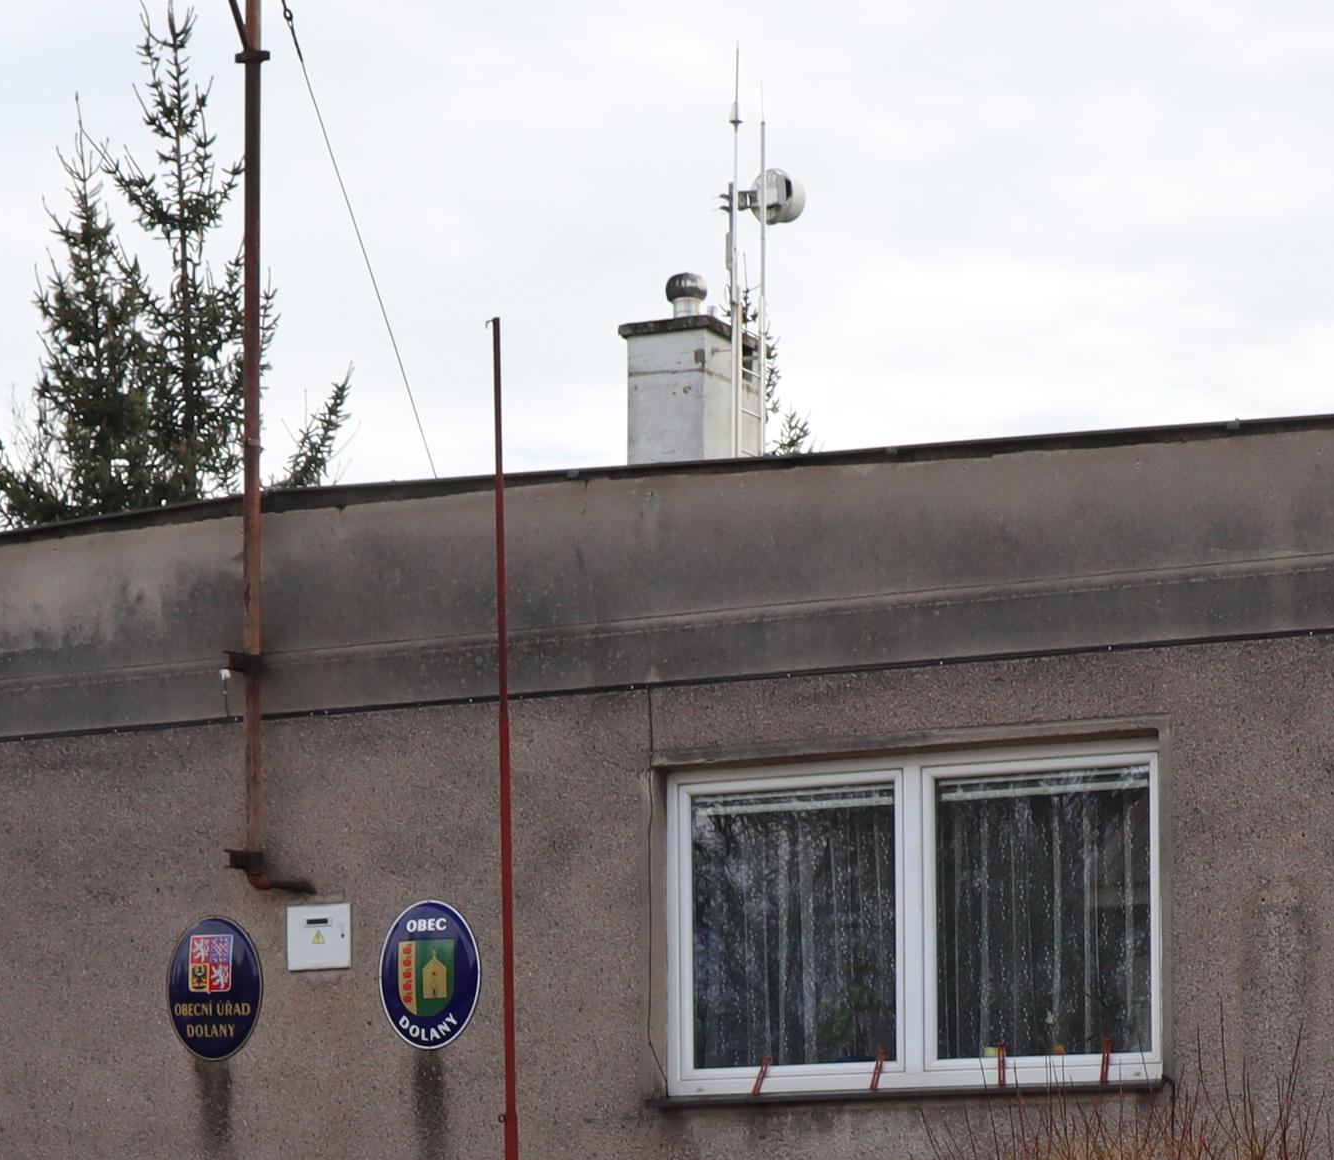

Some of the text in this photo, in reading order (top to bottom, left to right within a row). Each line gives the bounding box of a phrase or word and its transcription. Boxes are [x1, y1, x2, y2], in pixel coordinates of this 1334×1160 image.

[406, 917, 447, 933] OBEC
[174, 1000, 213, 1017] OBECNÍ
[186, 1024, 235, 1038] DOLANY
[398, 1012, 458, 1042] DOLANY
